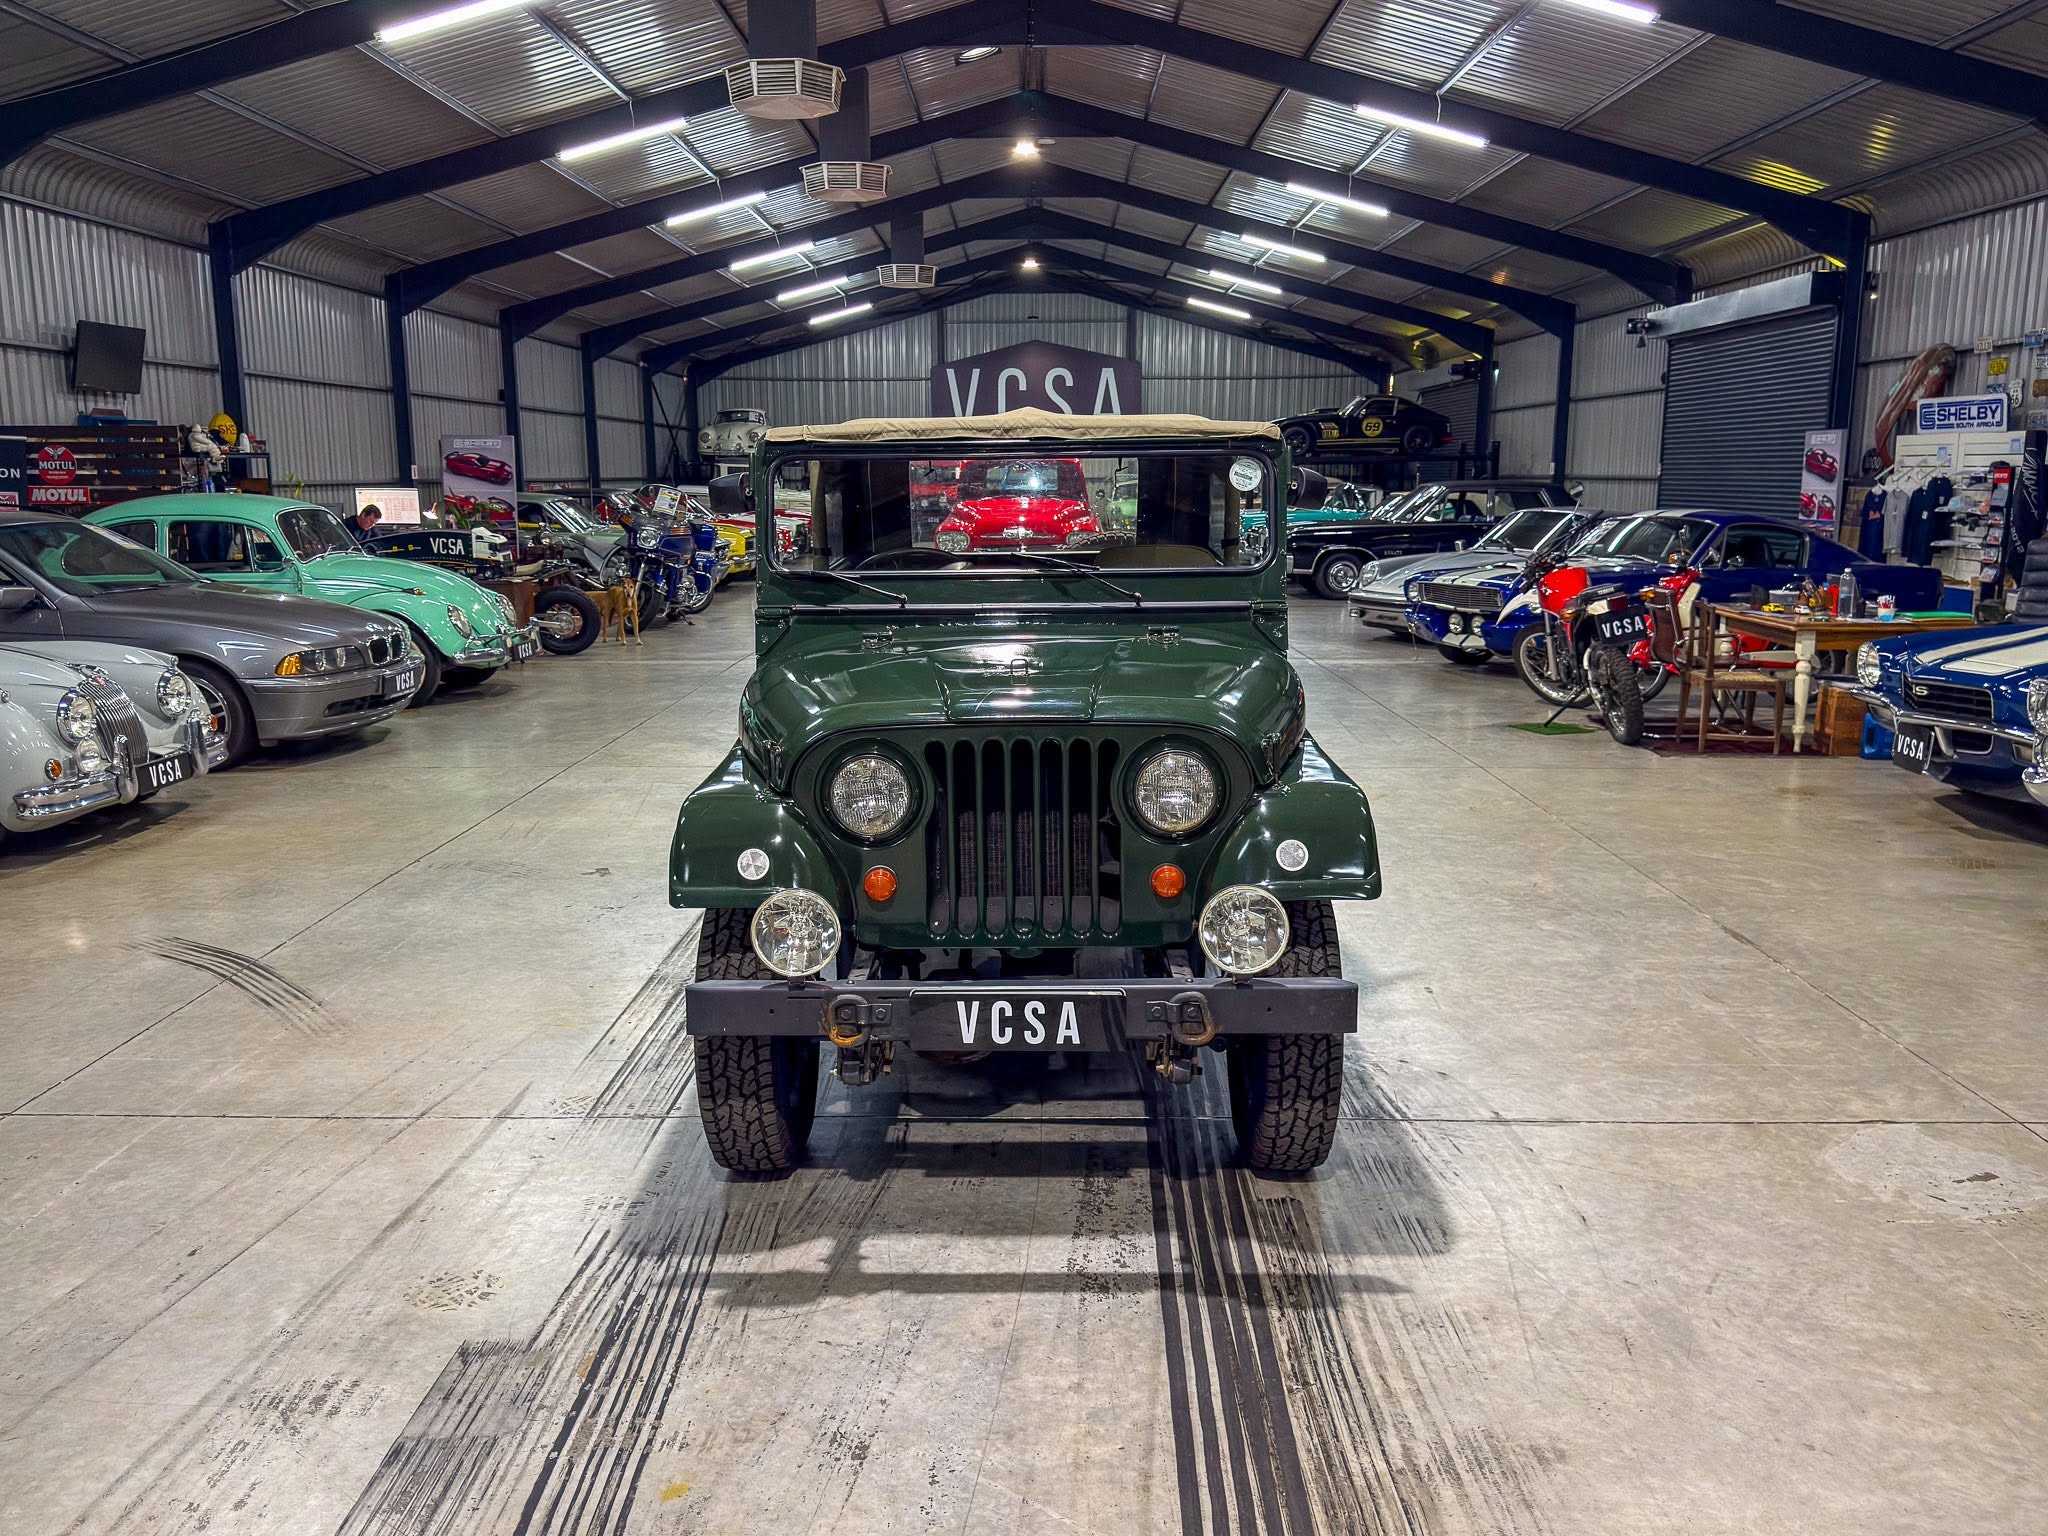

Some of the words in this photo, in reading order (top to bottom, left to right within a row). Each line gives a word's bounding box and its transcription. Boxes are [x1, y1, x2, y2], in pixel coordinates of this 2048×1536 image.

[946, 367, 1121, 417] VCSA
[1937, 405, 2000, 421] SHELBY
[1364, 422, 1380, 432] 69
[39, 461, 75, 470] MOTUL
[31, 488, 87, 502] MOTUL
[430, 537, 465, 555] VCSA
[1601, 615, 1644, 638] VCSA
[518, 642, 533, 659] VCSA
[395, 670, 415, 692] VCSA
[1897, 733, 1924, 761] VCSA
[149, 758, 182, 787] VCSA
[957, 1000, 1081, 1045] VCSA
